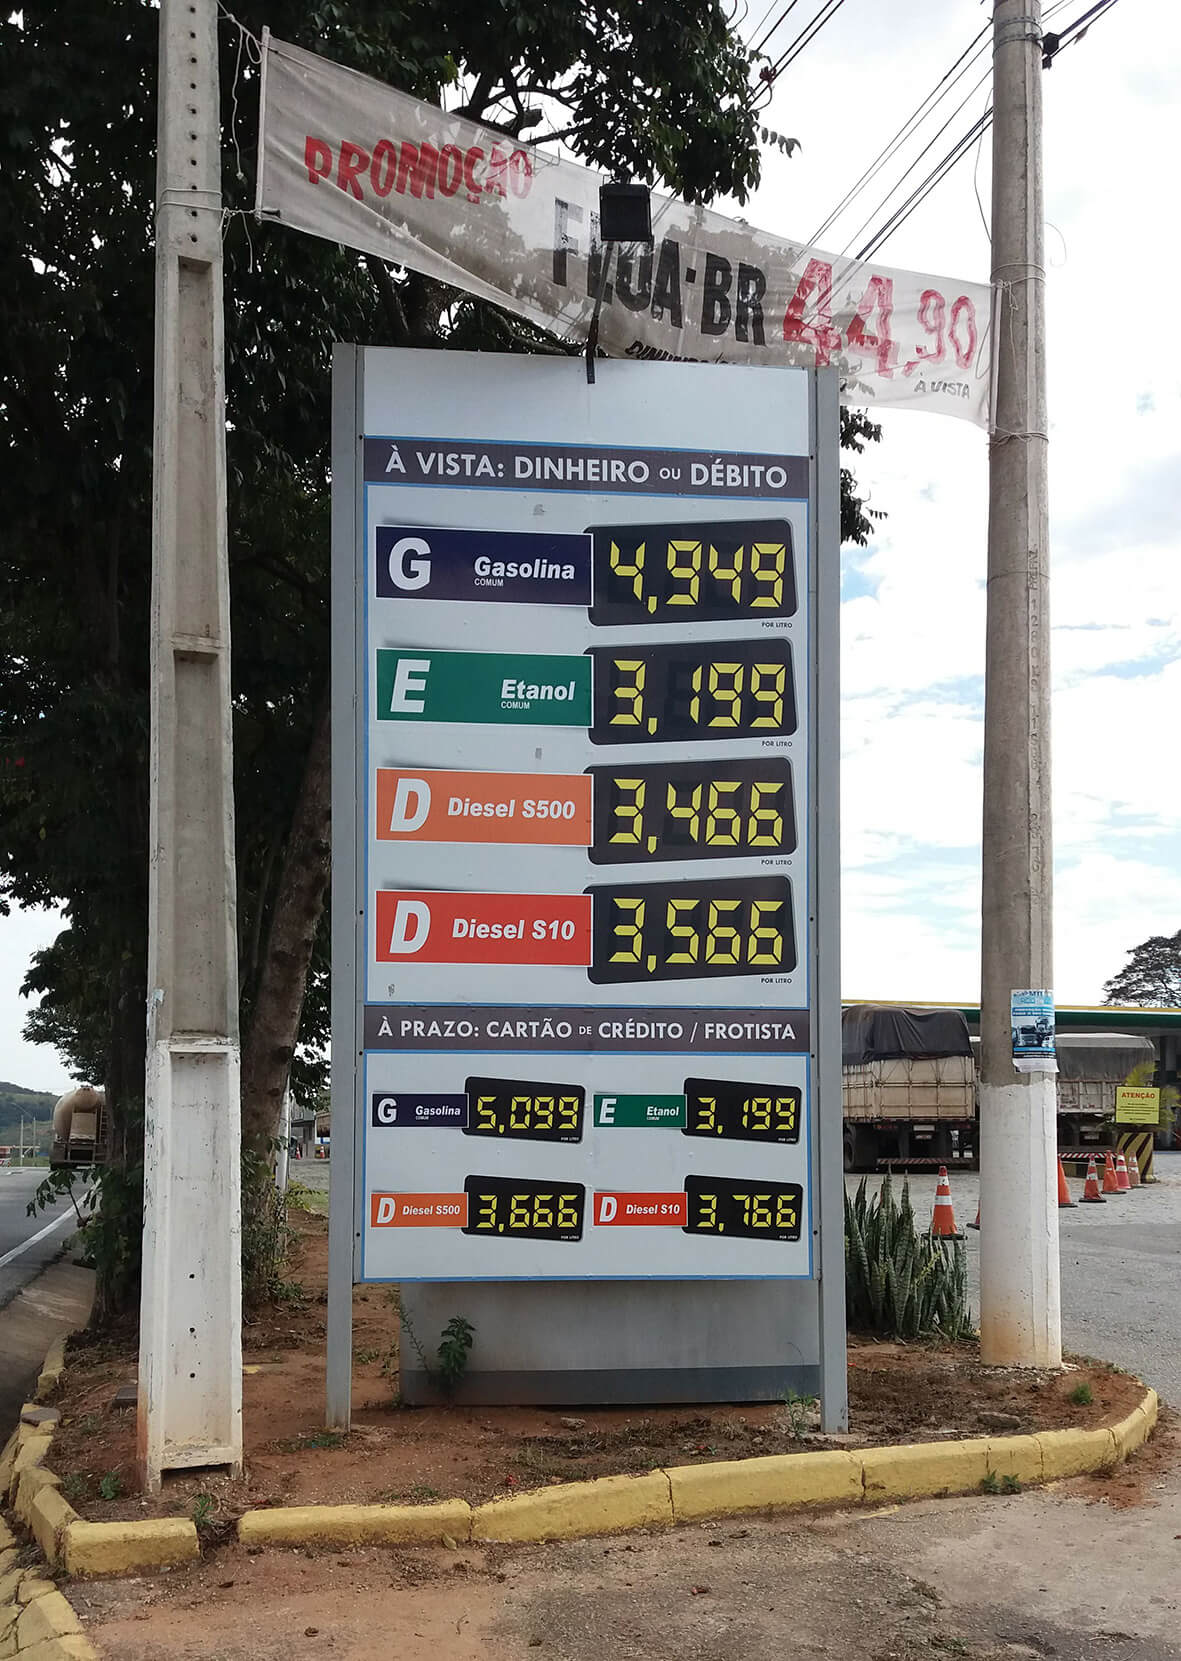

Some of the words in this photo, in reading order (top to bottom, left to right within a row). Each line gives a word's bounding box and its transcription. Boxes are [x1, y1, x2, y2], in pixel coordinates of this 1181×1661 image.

[304, 135, 533, 204] PROMOÇÃO
[783, 258, 977, 379] 44,90
[931, 380, 970, 399] VISTA
[385, 445, 407, 473] À
[416, 451, 504, 478] VISTA:
[514, 456, 650, 483] DINHEIRO
[659, 467, 681, 480] OU
[691, 458, 788, 488] DÉBITO
[389, 537, 431, 591] G
[474, 556, 575, 579] Gasolina
[474, 577, 504, 587] COMUM
[609, 539, 786, 614] 4,949
[390, 658, 431, 713] E
[501, 679, 576, 700] Etanol
[609, 659, 786, 735] 3,199
[500, 701, 531, 710] COMUM
[390, 778, 431, 832] D
[447, 797, 515, 817] Diesel
[522, 800, 576, 820] S500
[608, 778, 785, 854] 3,466
[389, 900, 431, 954] D
[452, 918, 525, 939] Diesel
[532, 920, 575, 940] S10
[608, 898, 784, 973] 3,566
[377, 1016, 393, 1037] À
[401, 1020, 479, 1037] PRAZO:
[486, 1018, 572, 1038] CARTÃO
[578, 1026, 592, 1035] DE
[599, 1018, 684, 1039] CRÉDITO
[690, 1022, 698, 1043] /
[704, 1023, 796, 1040] FROTISTA
[377, 1098, 397, 1123] G
[415, 1105, 461, 1116] Gasolina
[476, 1096, 579, 1134] 5,099
[599, 1098, 617, 1124] E
[646, 1106, 680, 1116] Etanol
[1121, 1092, 1156, 1100] ATENÇÃO
[695, 1097, 796, 1135] 3,199
[376, 1198, 396, 1224] D
[402, 1205, 433, 1216] Diesel
[435, 1205, 461, 1216] S500
[476, 1195, 579, 1232] 3,666
[599, 1196, 617, 1222] D
[626, 1204, 658, 1215] Diesel
[660, 1204, 680, 1215] S10
[696, 1195, 796, 1232] 3,766
